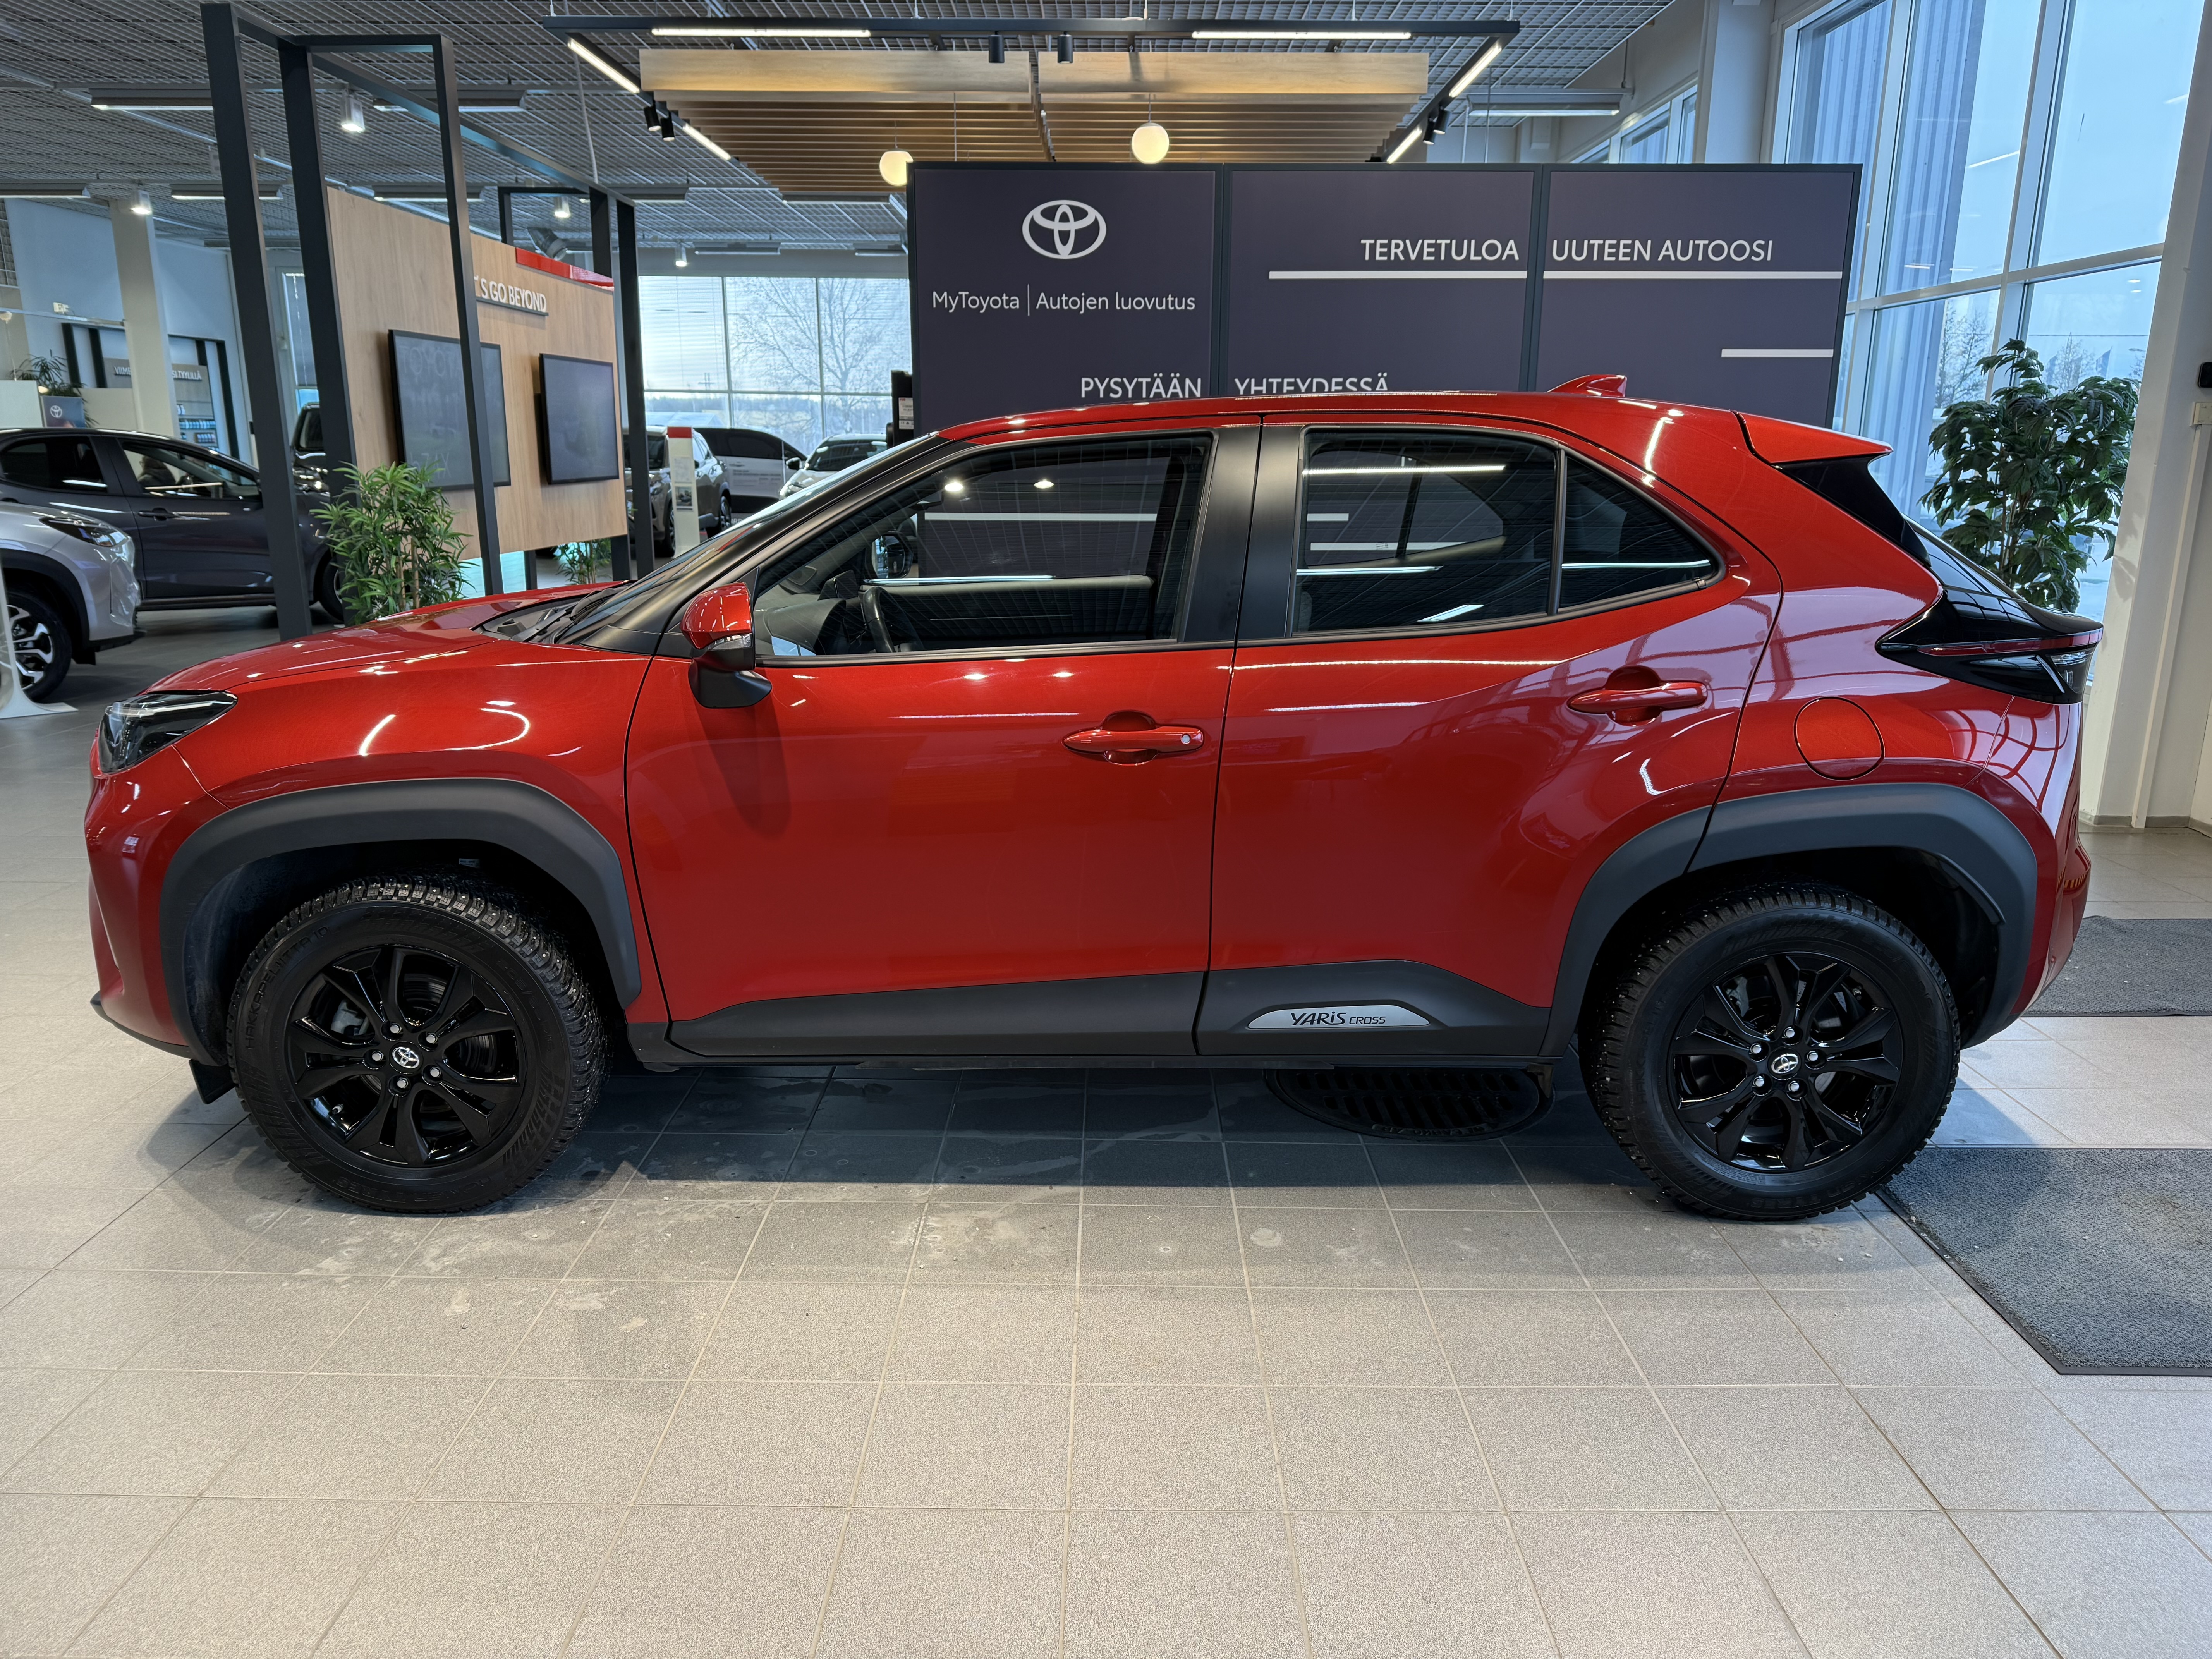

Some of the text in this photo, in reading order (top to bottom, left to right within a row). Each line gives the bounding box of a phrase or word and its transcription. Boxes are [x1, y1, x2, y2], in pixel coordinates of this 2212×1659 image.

[1360, 239, 1774, 262] TERVETULOA UUTEEN AUTOOSI
[489, 280, 507, 303] GO
[508, 285, 547, 313] BEYOND
[932, 291, 1196, 314] MyToyota Autojen luovutus
[1081, 373, 1388, 398] PYSYTÄÄN YHTEYDESSÄ
[245, 936, 312, 1050] HAKKAPELIITTA
[1349, 1016, 1386, 1025] CROSS
